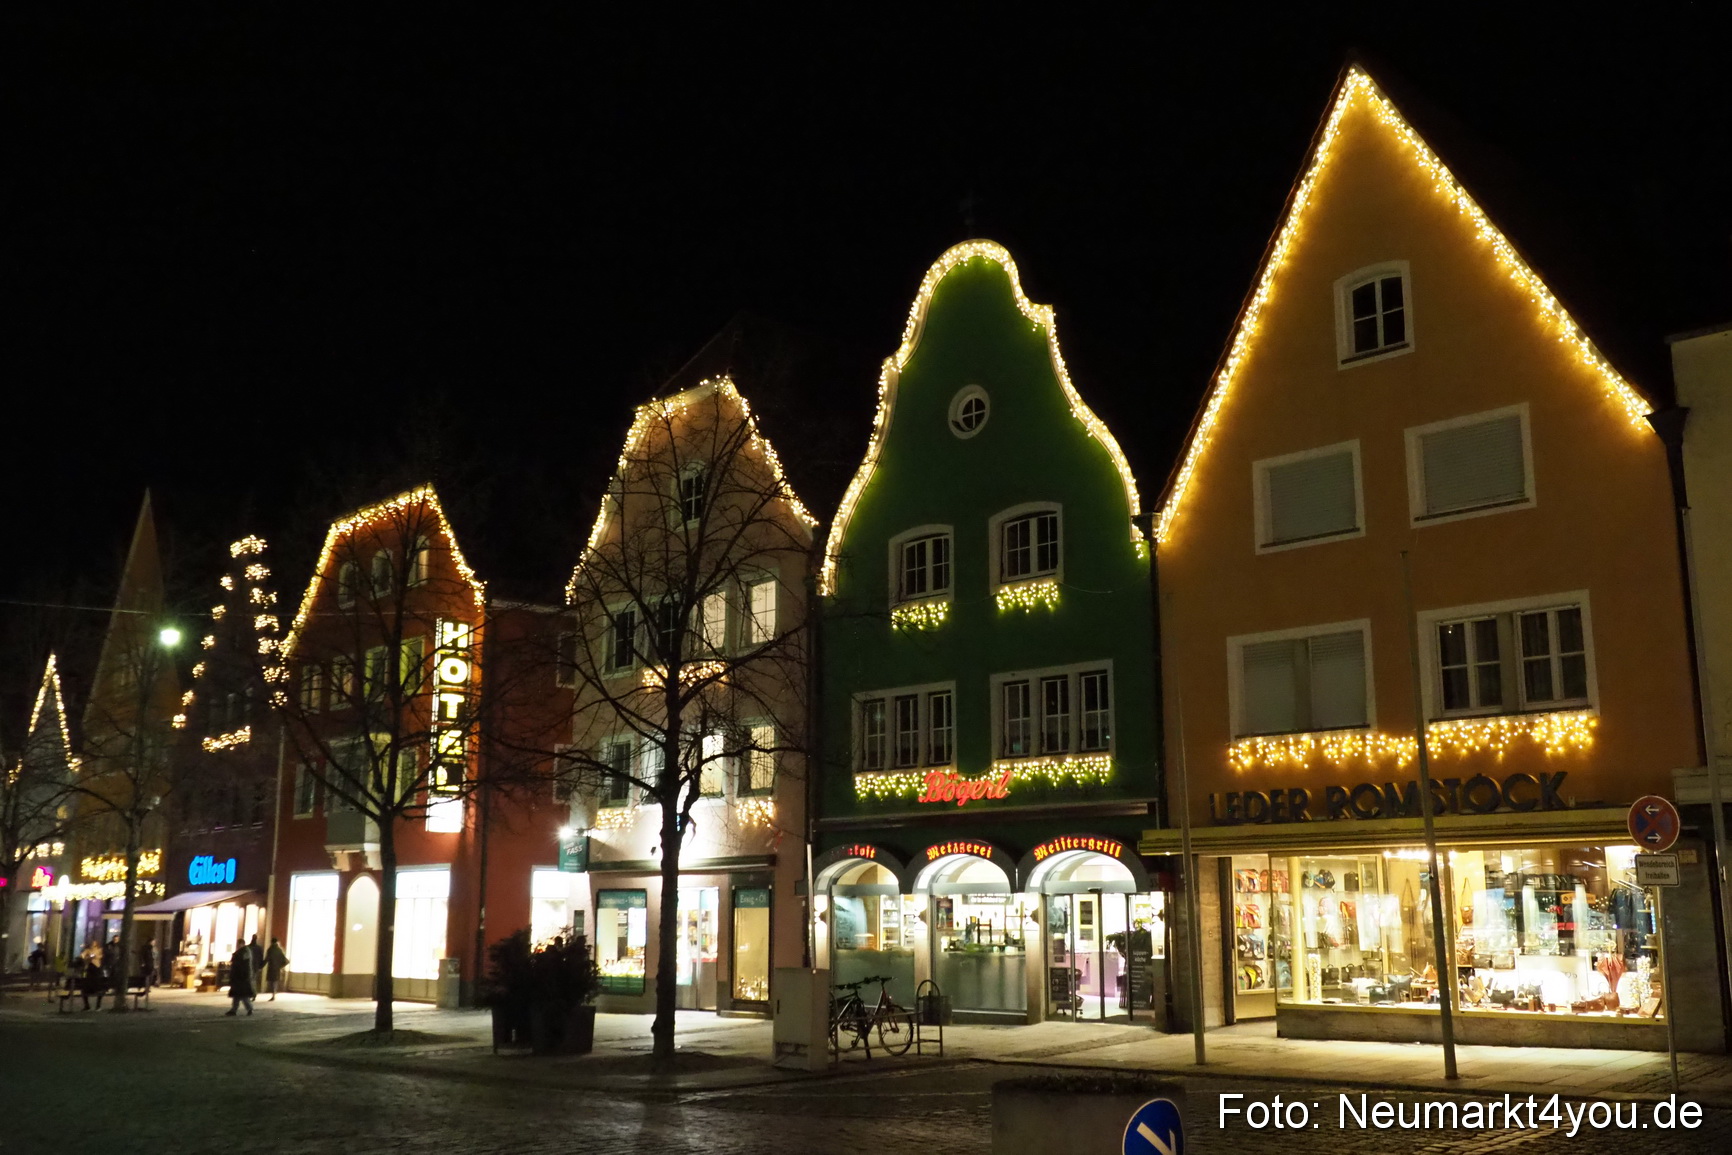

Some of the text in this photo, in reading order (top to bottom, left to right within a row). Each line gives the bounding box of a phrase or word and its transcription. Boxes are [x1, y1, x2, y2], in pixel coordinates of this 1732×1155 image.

[436, 621, 469, 793] HOTEL
[918, 770, 1012, 807] Bögerl
[1209, 771, 1568, 824] LEDER ROMSTOCK
[926, 841, 993, 861] Metzgerei
